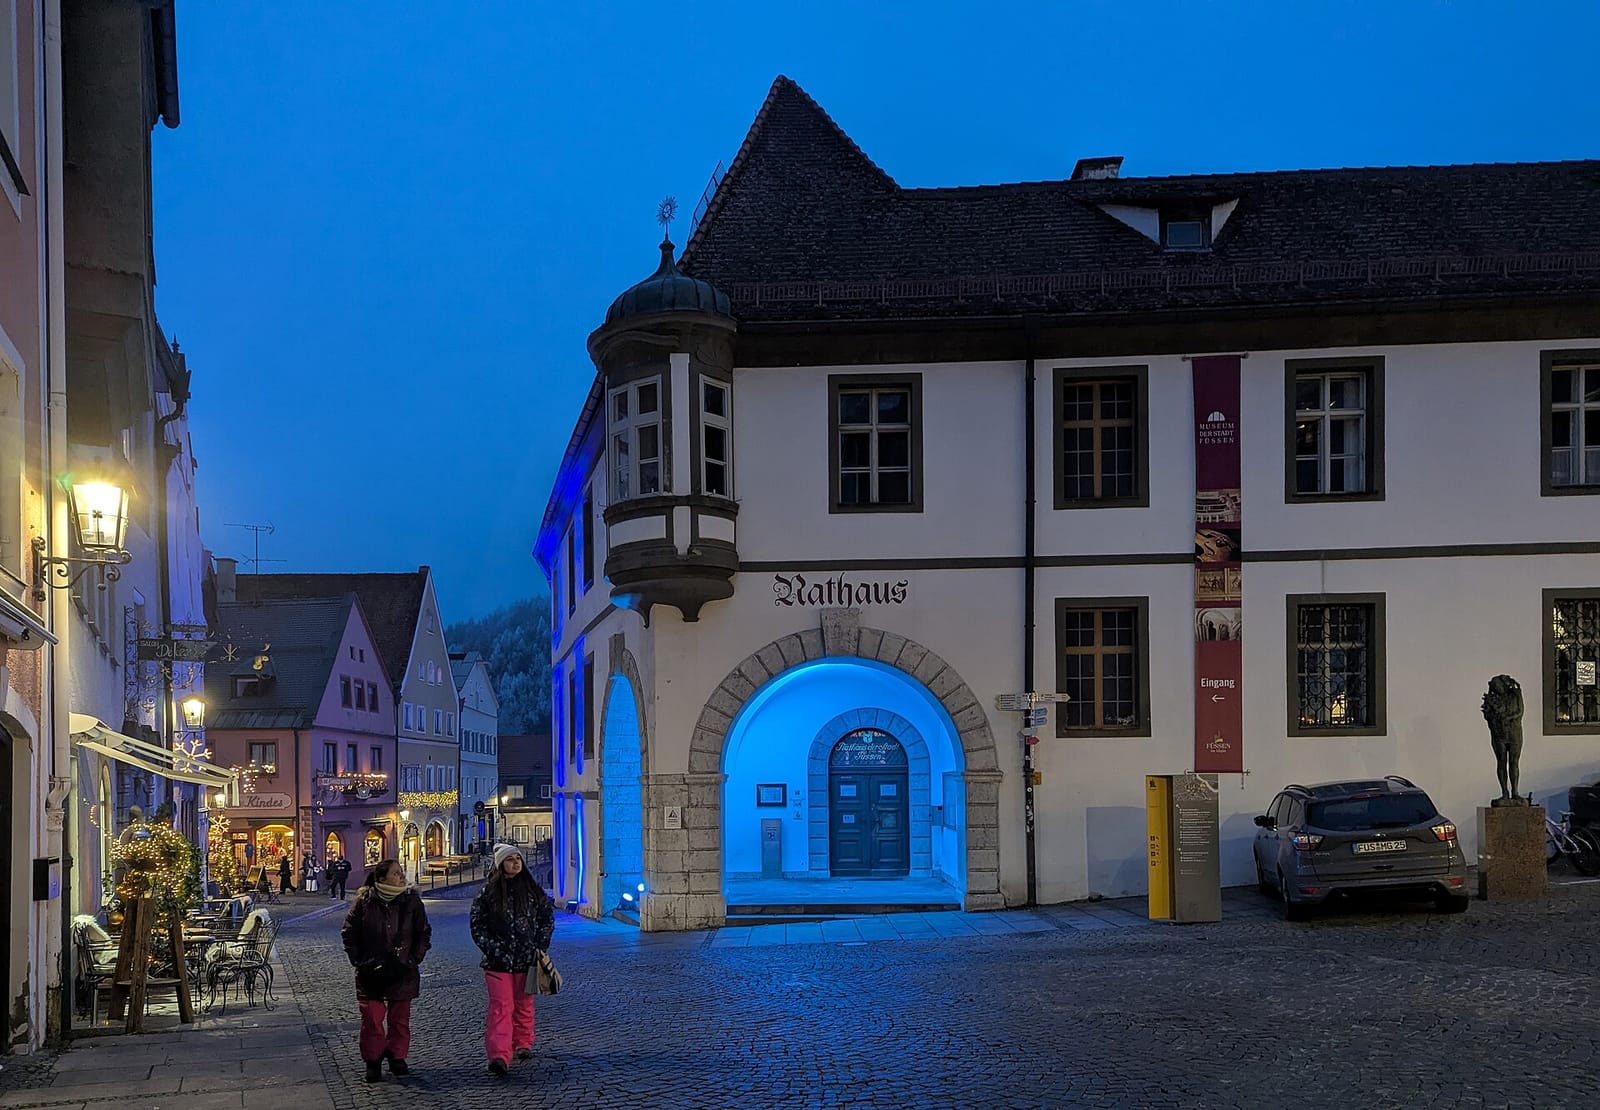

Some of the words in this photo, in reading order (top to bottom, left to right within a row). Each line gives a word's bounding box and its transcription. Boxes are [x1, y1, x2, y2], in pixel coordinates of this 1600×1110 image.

[1199, 422, 1235, 430] MUSEUM
[1199, 430, 1213, 438] DER
[1213, 429, 1234, 437] STADT
[773, 572, 909, 609] Rathaus
[1201, 677, 1235, 689] Eingang
[245, 795, 283, 808] Kindes
[1393, 841, 1406, 849] 25
